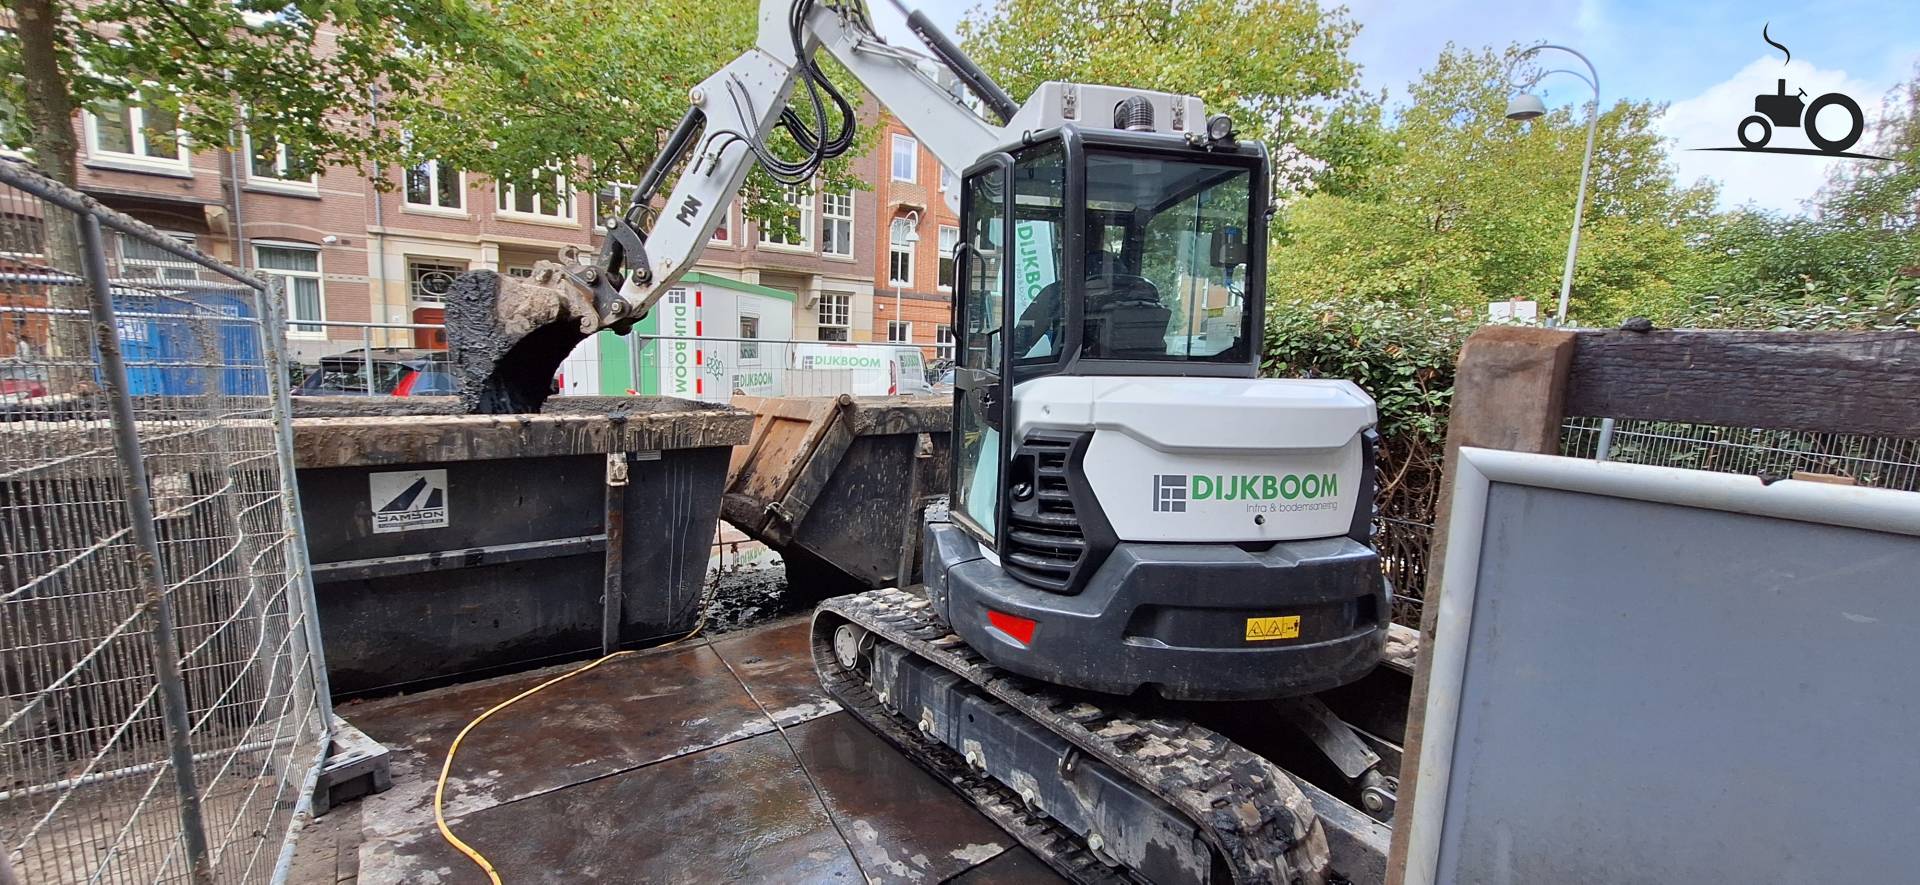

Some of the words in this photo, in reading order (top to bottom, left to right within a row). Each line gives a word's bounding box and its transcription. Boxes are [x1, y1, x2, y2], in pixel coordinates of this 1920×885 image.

[676, 194, 702, 227] MN
[1017, 225, 1042, 300] DIJKBO
[674, 305, 687, 393] DIJKBOOM
[815, 355, 881, 368] DIJKBOOM
[740, 371, 773, 388] DIJKBOOM
[1191, 473, 1338, 501] DIJKBOOM
[377, 510, 444, 523] SAMSON
[1246, 503, 1267, 513] Infra
[1269, 502, 1277, 513] &
